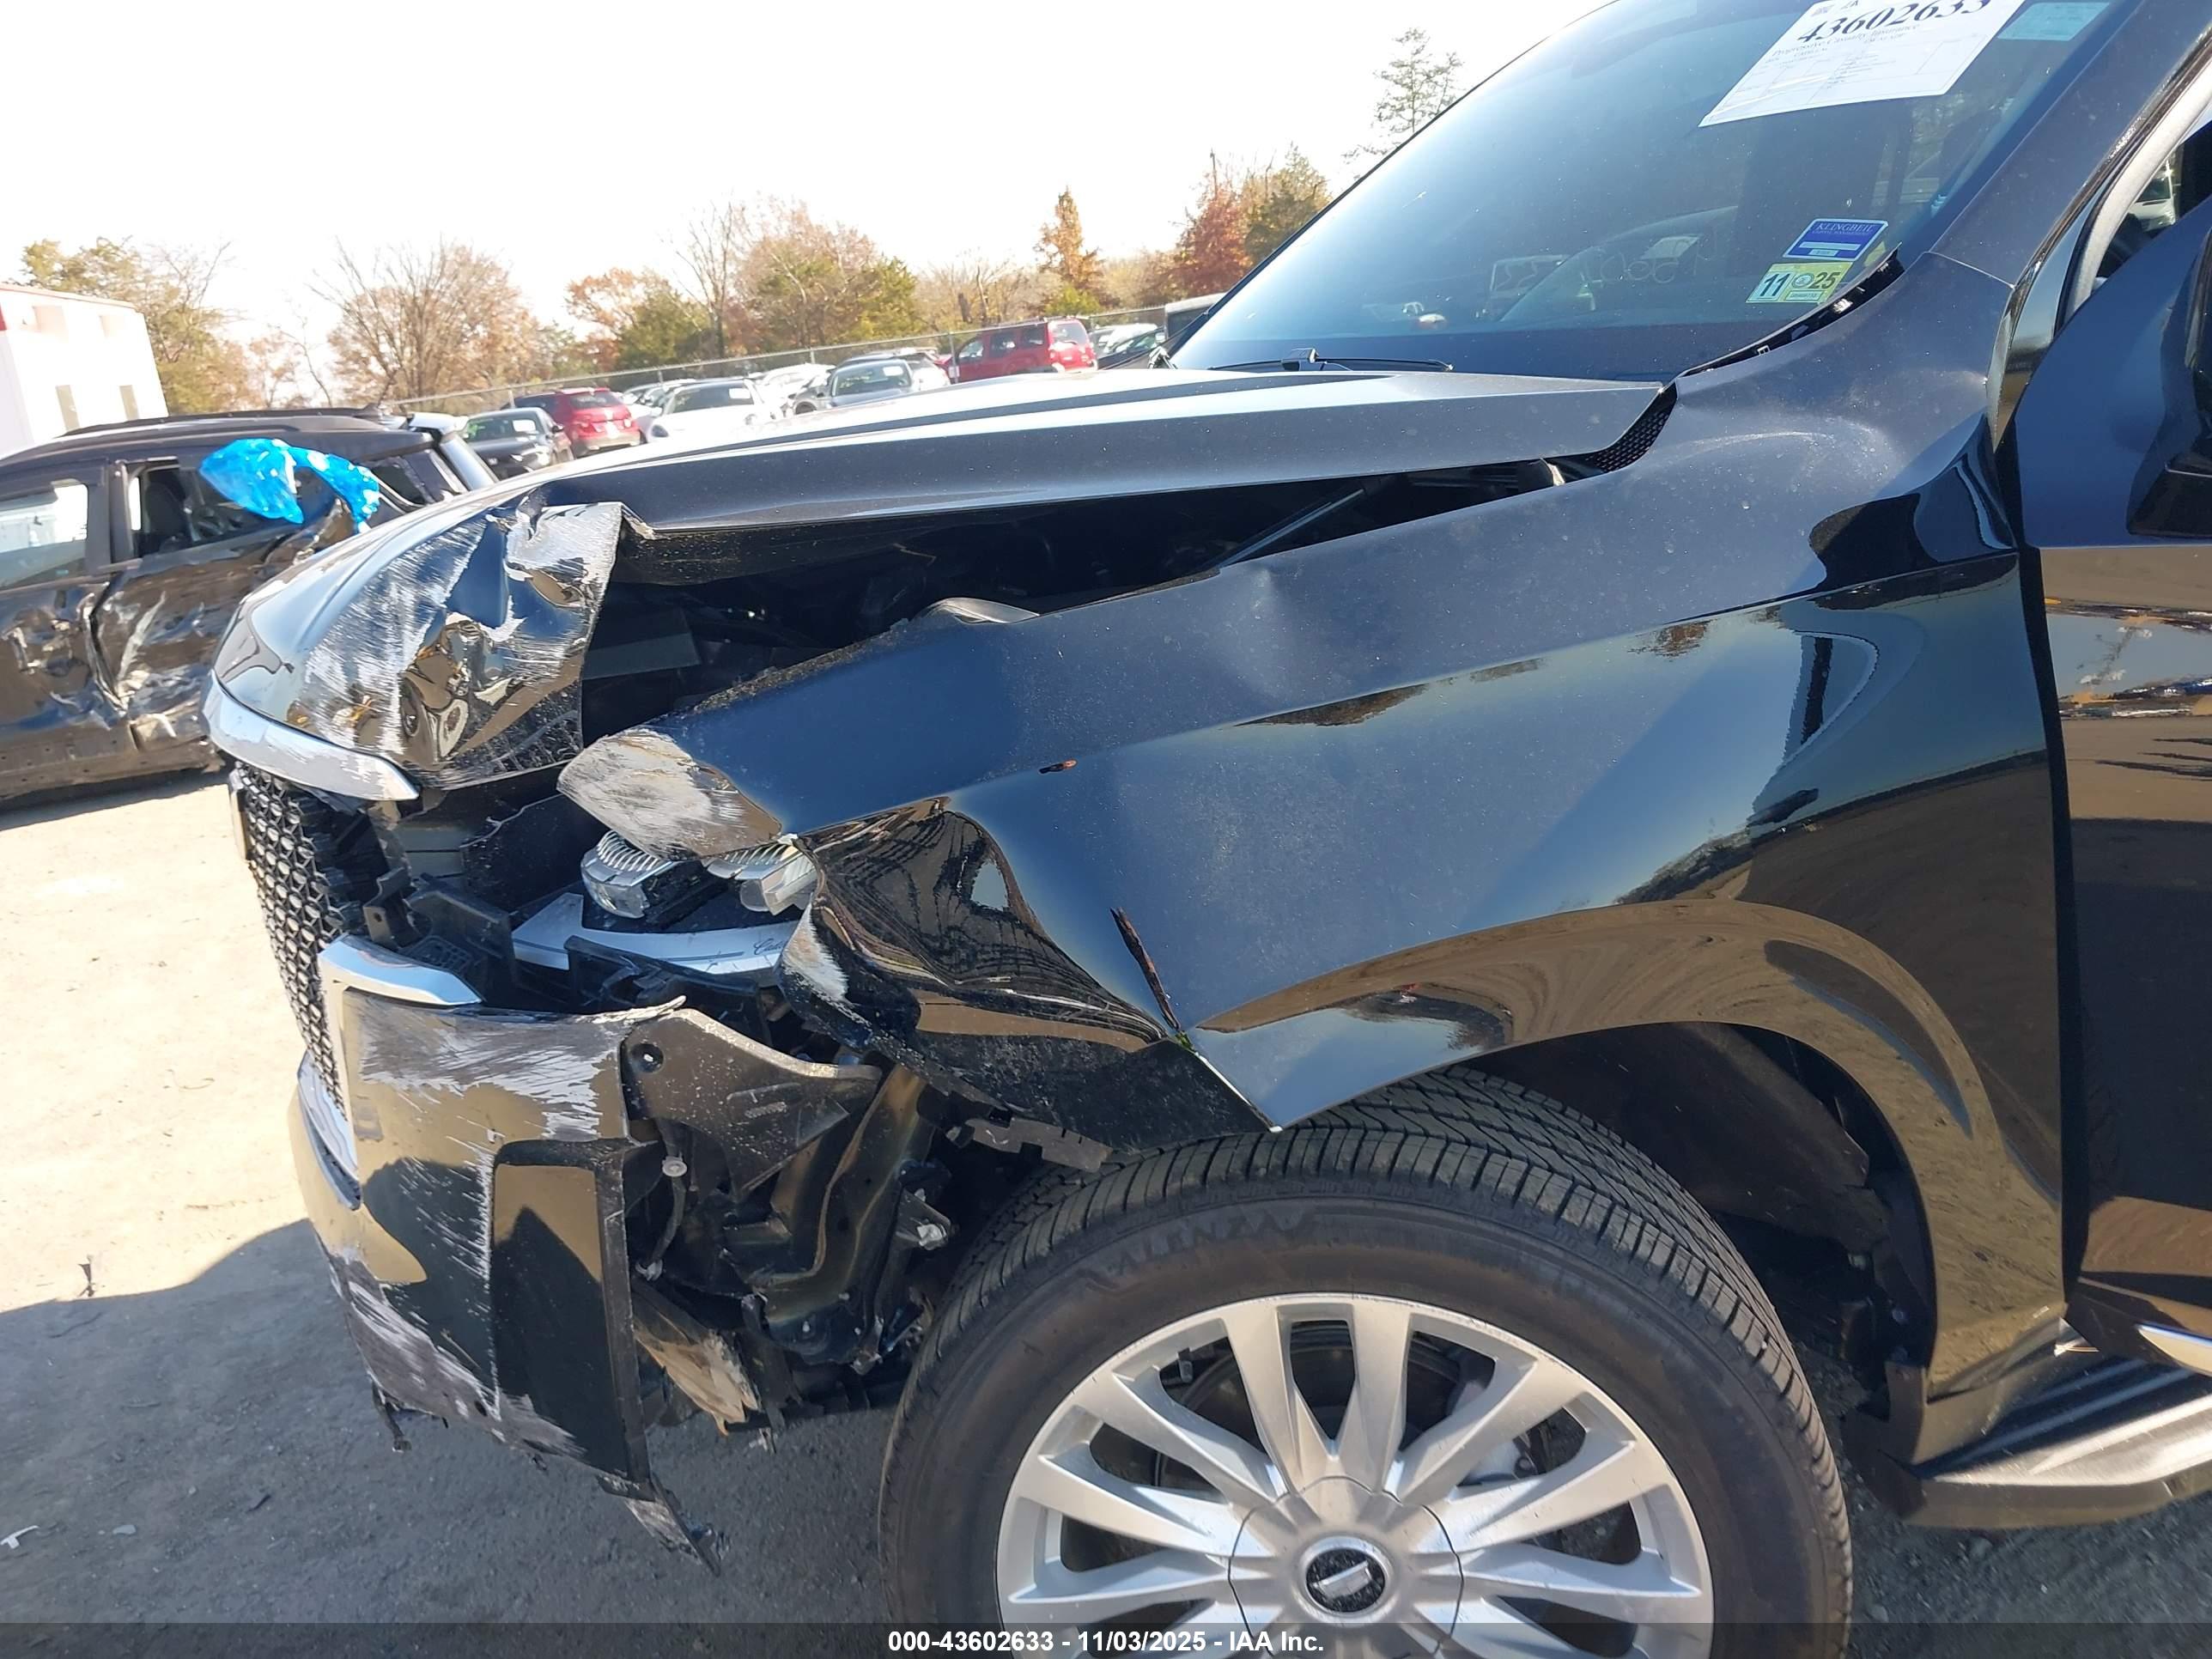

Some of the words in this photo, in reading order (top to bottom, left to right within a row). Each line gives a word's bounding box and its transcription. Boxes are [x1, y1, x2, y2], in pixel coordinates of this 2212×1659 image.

[1796, 0, 1991, 43] 43602633
[1816, 222, 1875, 233] KLINGBEIL
[1759, 273, 1790, 297] 11
[1808, 272, 1841, 289] 25
